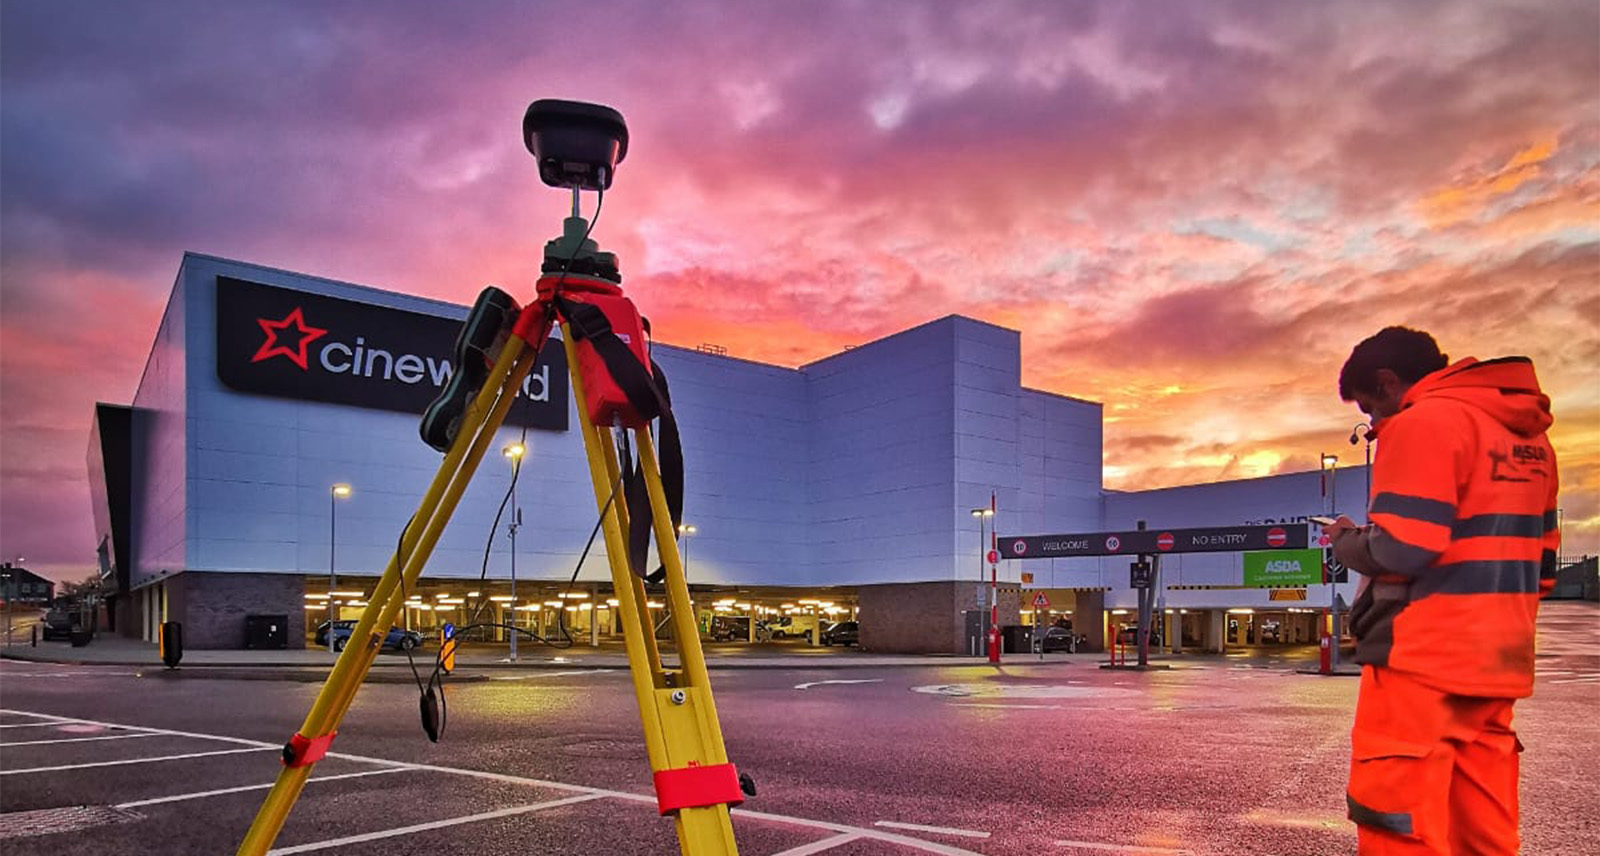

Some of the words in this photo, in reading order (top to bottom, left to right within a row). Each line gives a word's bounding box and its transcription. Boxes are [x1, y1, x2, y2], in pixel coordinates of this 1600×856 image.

[320, 337, 549, 402] cinewd
[1042, 540, 1089, 551] WELCOME
[1192, 535, 1209, 545] NO
[1211, 533, 1247, 545] ENTRY
[1264, 559, 1302, 574] ASDA
